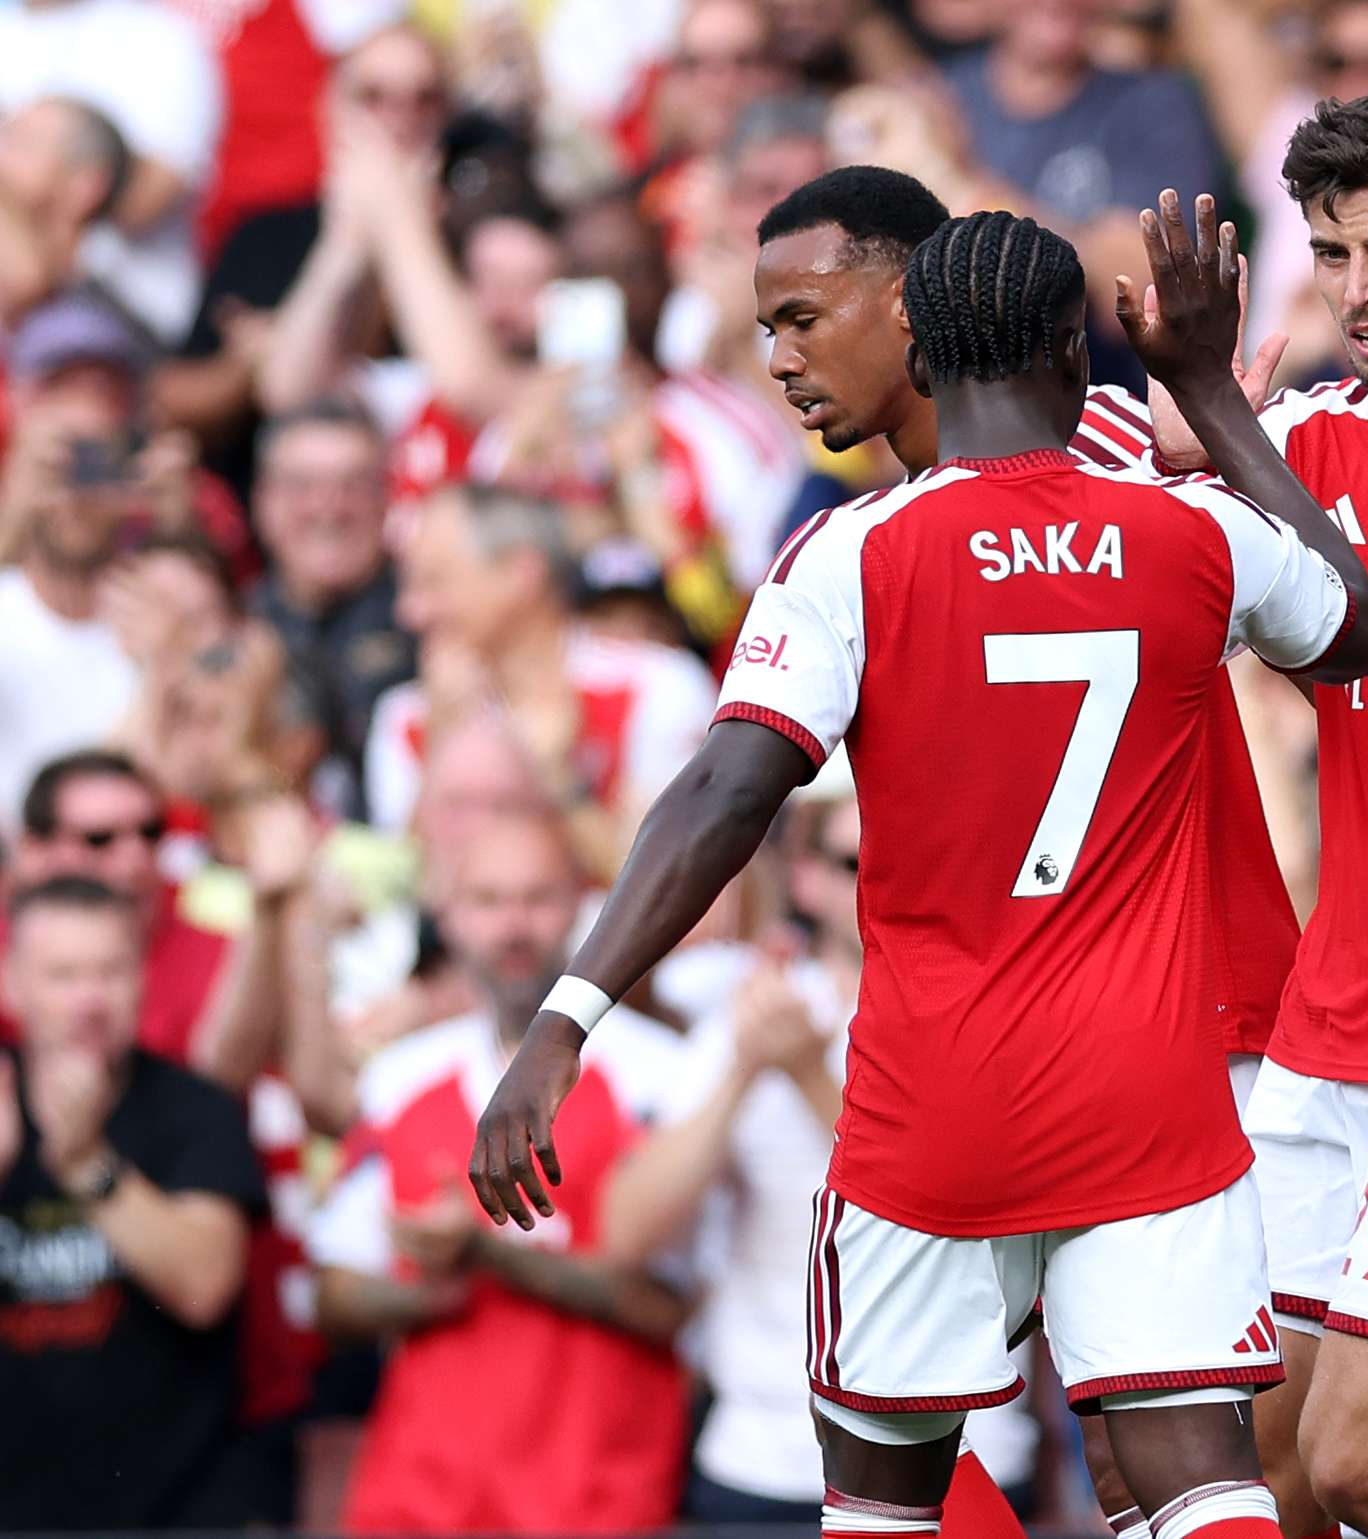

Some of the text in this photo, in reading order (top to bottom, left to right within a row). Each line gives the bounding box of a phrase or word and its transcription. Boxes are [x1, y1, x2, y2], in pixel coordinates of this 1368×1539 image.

[969, 520, 1125, 582] SAKA
[729, 634, 789, 672] eel.
[983, 628, 1141, 898] 7
